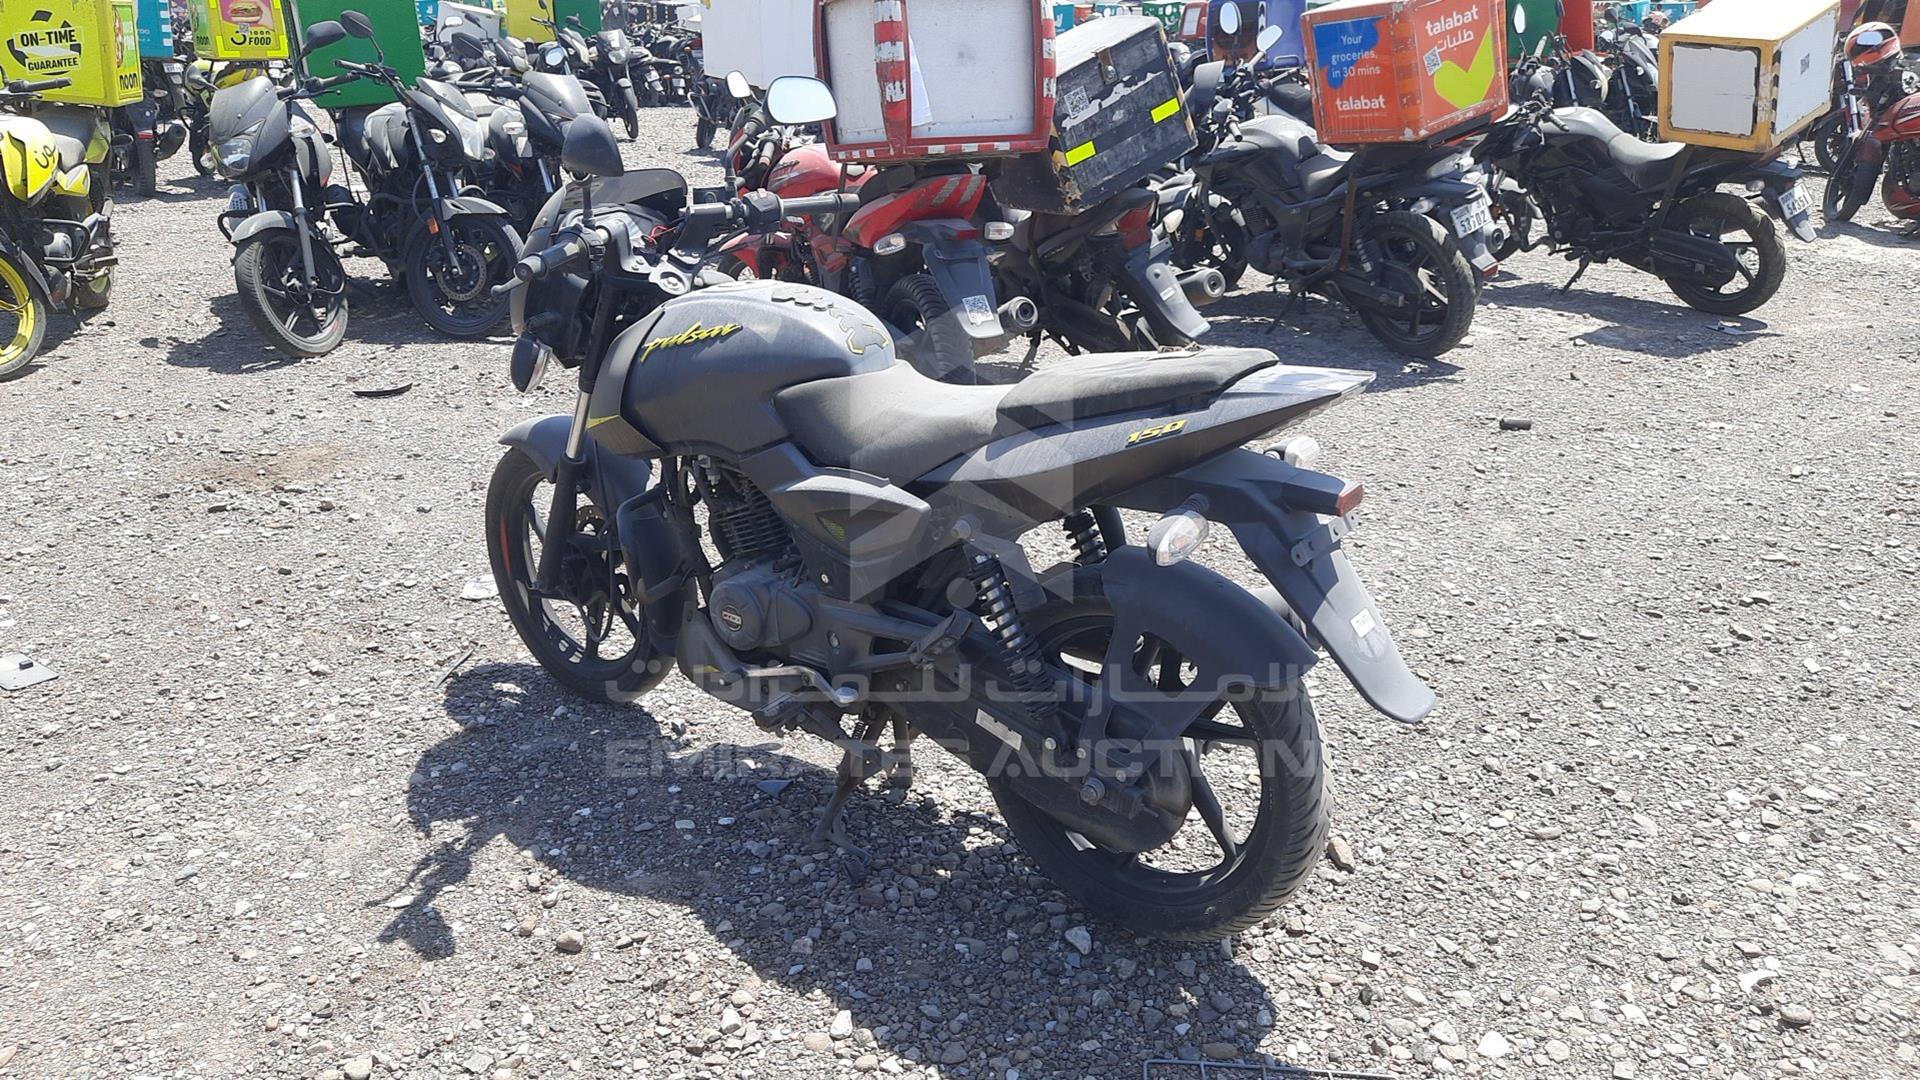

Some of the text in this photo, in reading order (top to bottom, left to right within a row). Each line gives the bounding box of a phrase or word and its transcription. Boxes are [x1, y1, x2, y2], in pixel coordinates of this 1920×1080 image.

[1425, 4, 1478, 37] talabat
[20, 29, 77, 47] ON-TIME
[248, 37, 271, 46] FOOD
[1340, 35, 1362, 45] Your
[1437, 28, 1474, 52] طلبات
[27, 57, 79, 71] GUARANTEE
[1332, 64, 1381, 78] in 30 mins
[119, 73, 138, 90] noon
[1336, 95, 1386, 111] talabat
[640, 321, 743, 363] pulsar
[1127, 420, 1187, 443] 150
